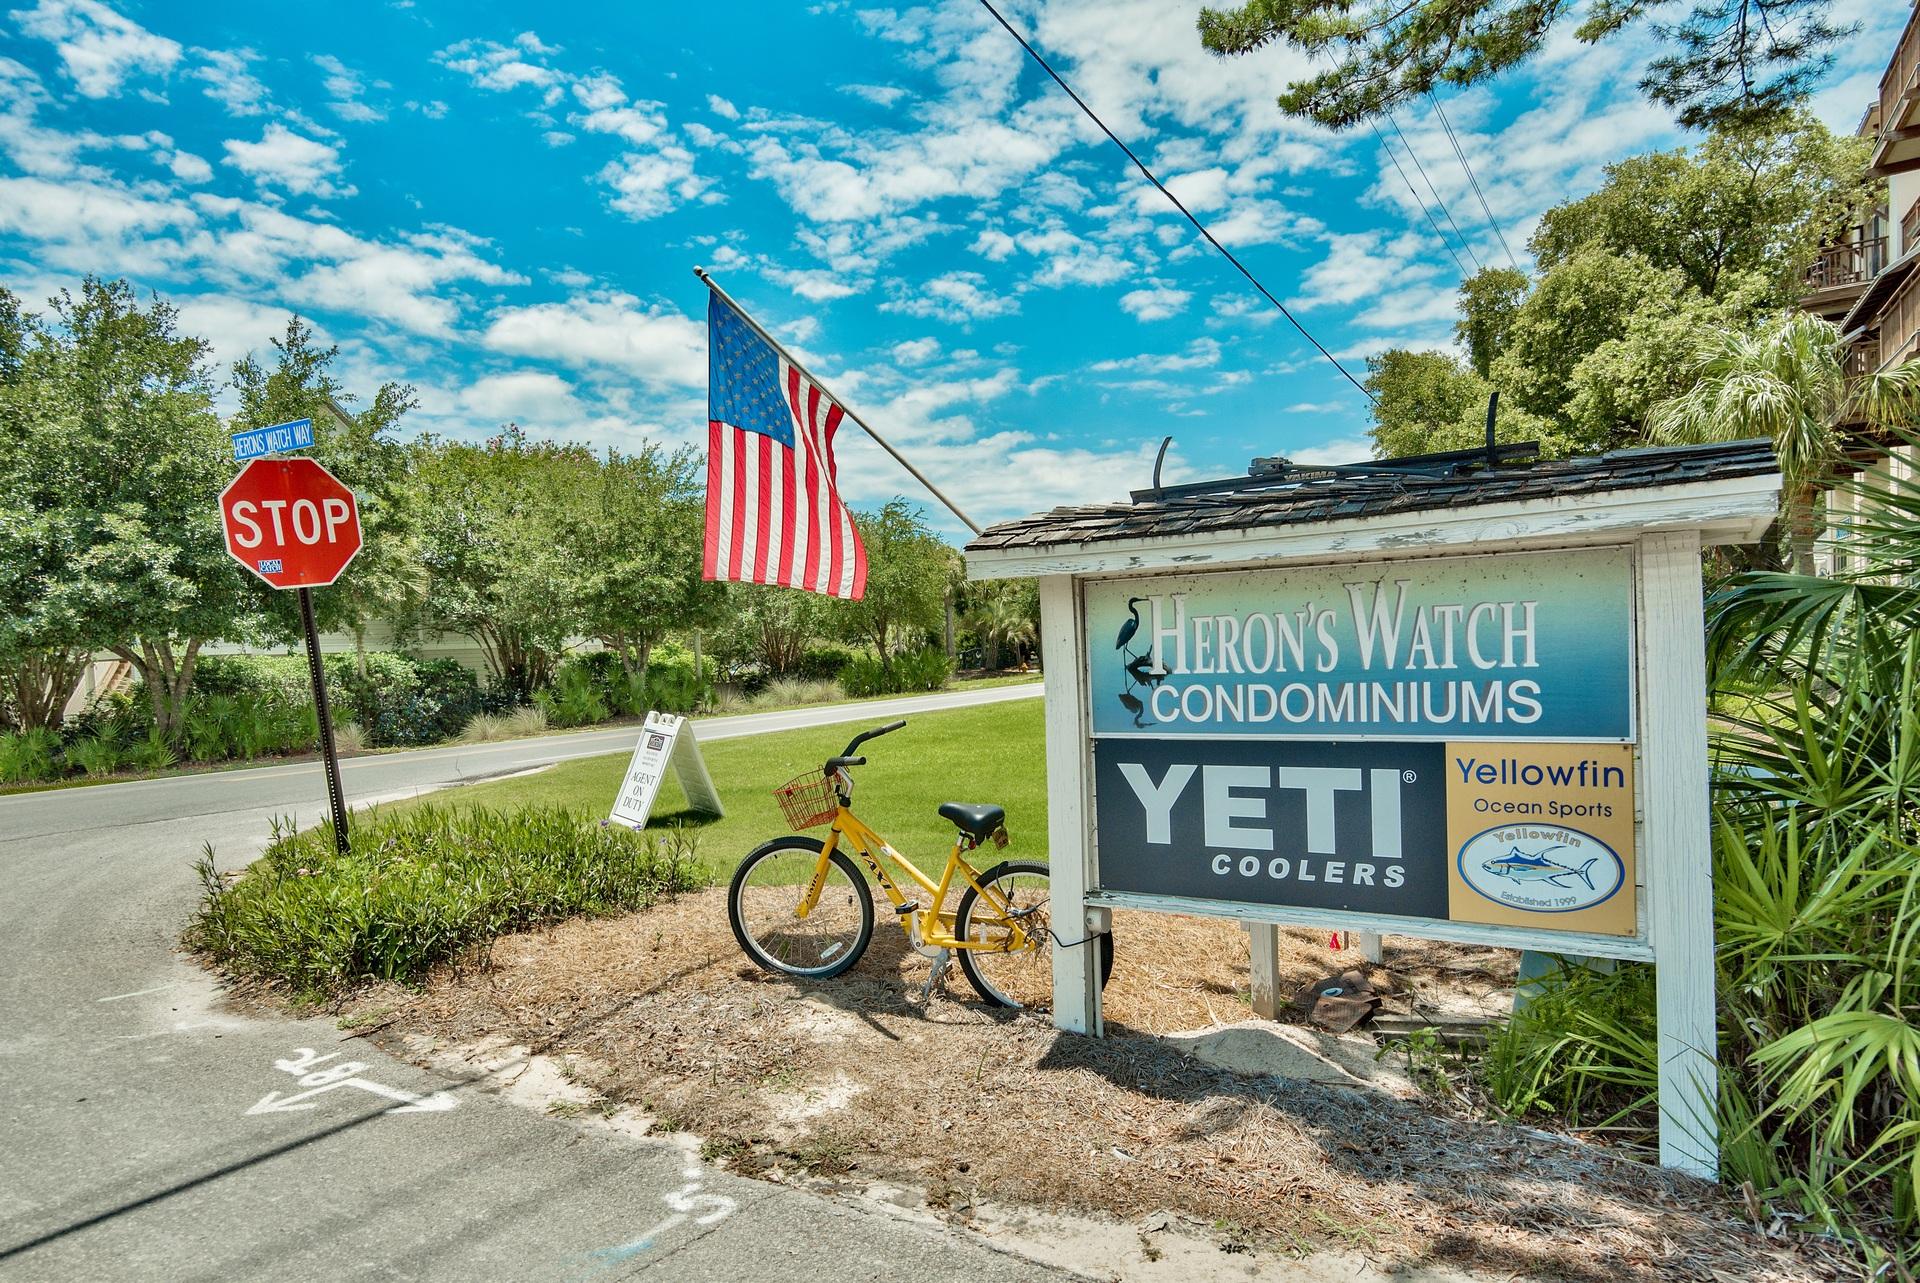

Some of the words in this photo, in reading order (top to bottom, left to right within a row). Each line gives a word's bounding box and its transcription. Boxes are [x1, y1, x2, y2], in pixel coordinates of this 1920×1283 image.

[232, 433, 265, 457] HERONS
[265, 428, 292, 450] WATCH
[293, 423, 311, 446] WAY
[232, 498, 350, 548] STOP
[1146, 594, 1340, 676] HERON'S
[1342, 579, 1540, 670] WATCH
[1150, 680, 1543, 725] CONDOMINIUMS
[631, 771, 656, 787] AGENT
[1455, 757, 1625, 788] Yellowfin
[622, 796, 645, 812] DUTY
[632, 784, 645, 796] ON
[1473, 798, 1543, 815] Ocean
[1548, 800, 1613, 818] Sports
[1493, 827, 1582, 848] Yellowfin
[860, 848, 892, 889] TAXI
[1211, 853, 1406, 888] COOLERS
[1500, 891, 1552, 908] Established
[1554, 896, 1577, 908] 1999
